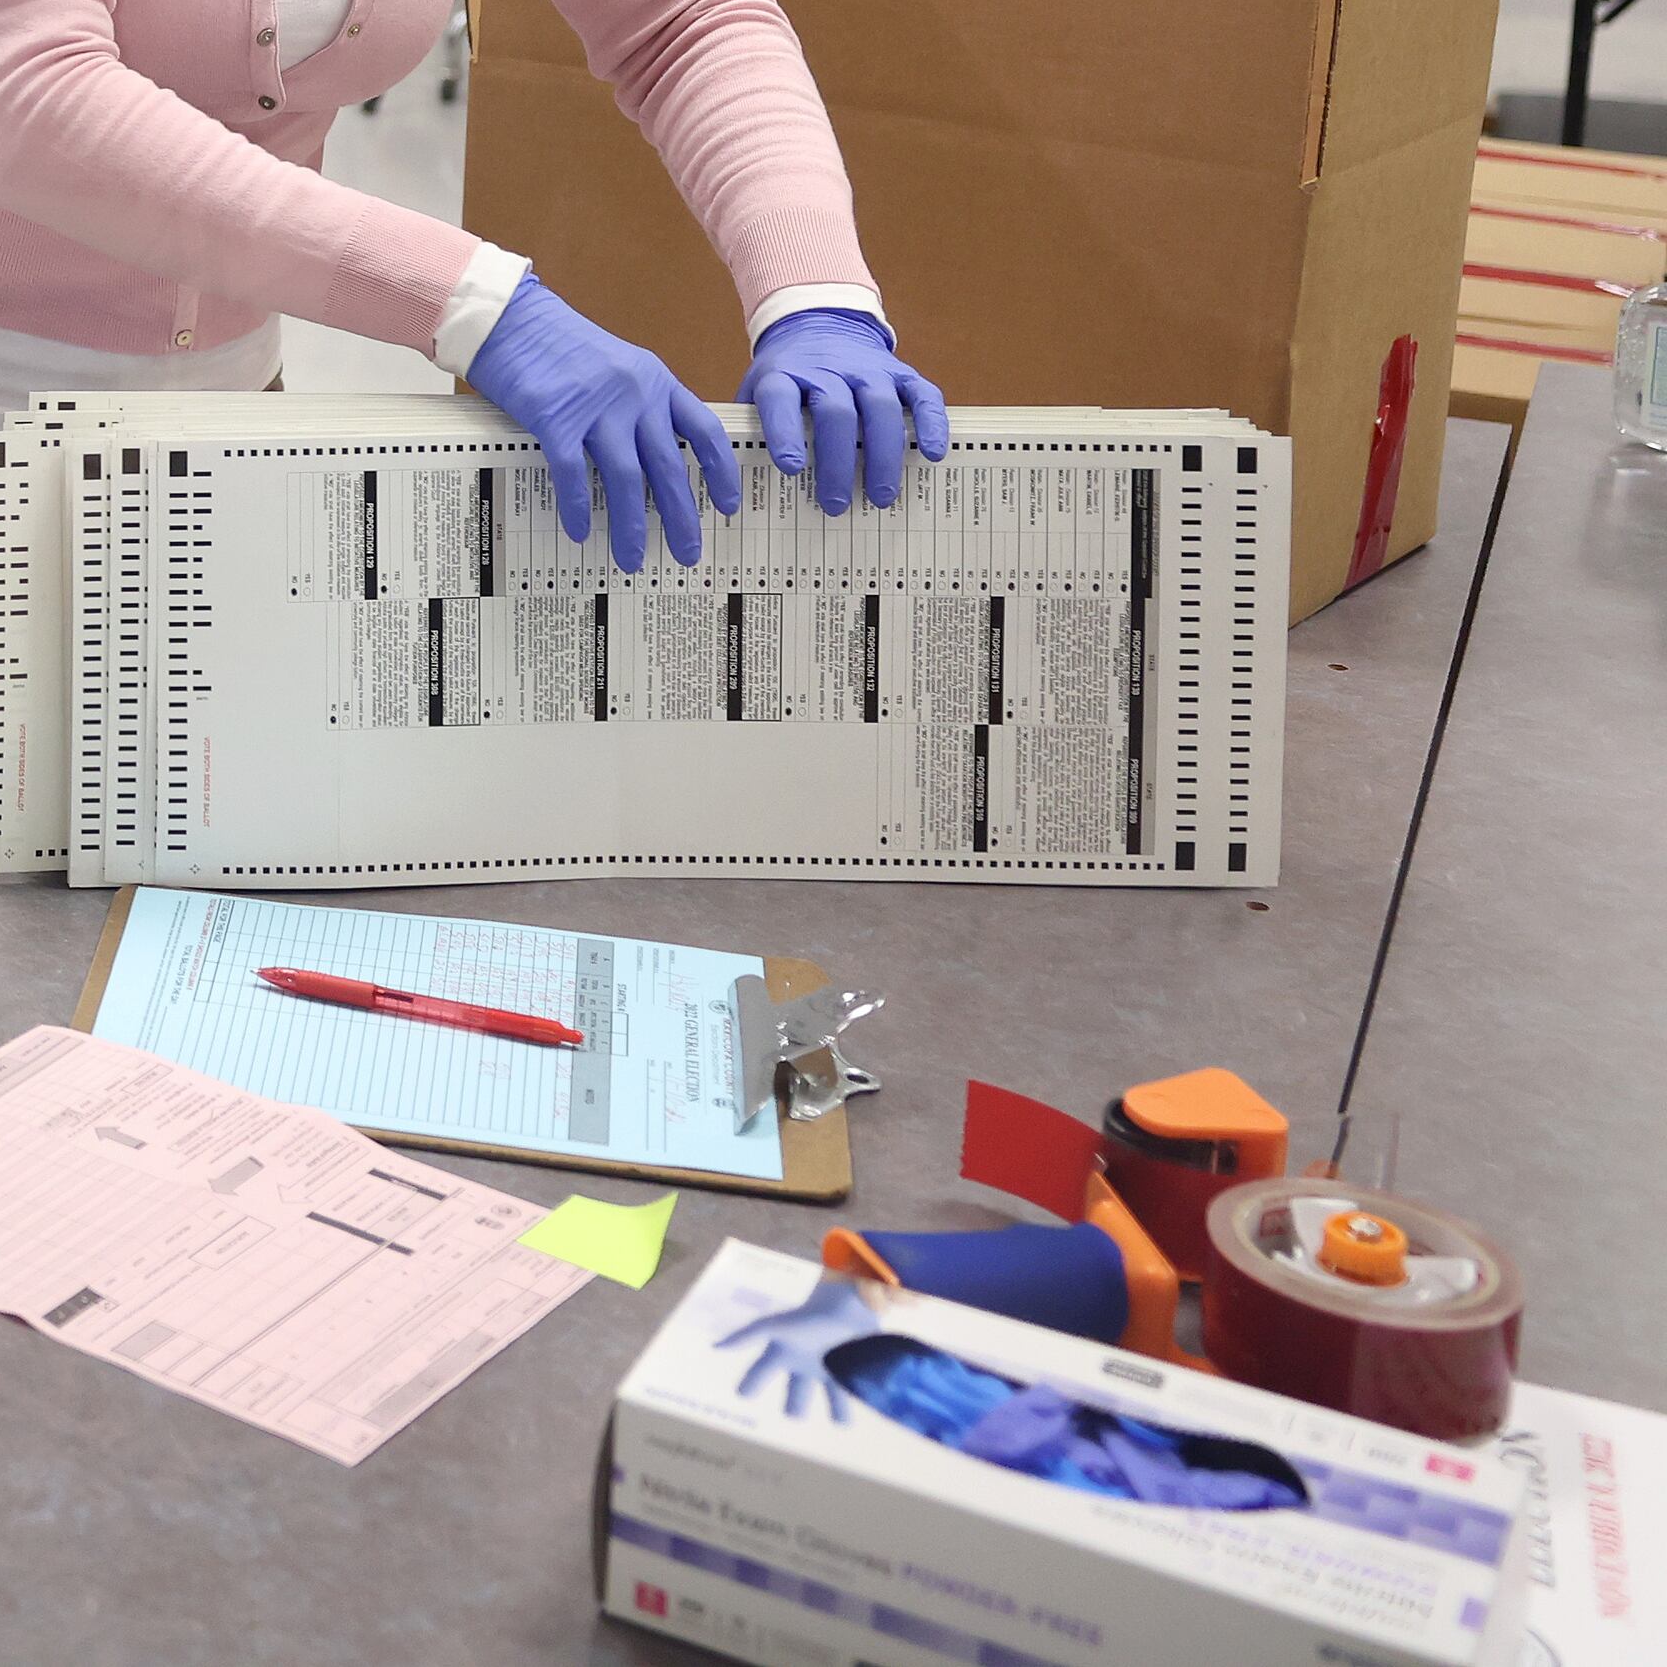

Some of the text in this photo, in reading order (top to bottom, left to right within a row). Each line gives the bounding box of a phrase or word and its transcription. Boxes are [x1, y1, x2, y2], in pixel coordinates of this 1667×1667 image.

[365, 502, 374, 568] PROPOSITION 129
[481, 499, 490, 551] PROPOSITION
[430, 630, 439, 681] PROPOSITION
[596, 625, 605, 690] PROPOSITION 211
[729, 624, 738, 675] PROPOSITION
[866, 626, 875, 691] PROPOSITION 132
[991, 628, 1000, 693] PROPOSITION 131
[1131, 629, 1141, 695] PROPOSITION 130
[19, 778, 25, 786] OF
[204, 793, 210, 801] OF
[976, 756, 985, 807] PROPOSITION
[1129, 758, 1139, 807] PROPOSITION
[685, 1003, 700, 1103] 2022 GENERAL ELECTION
